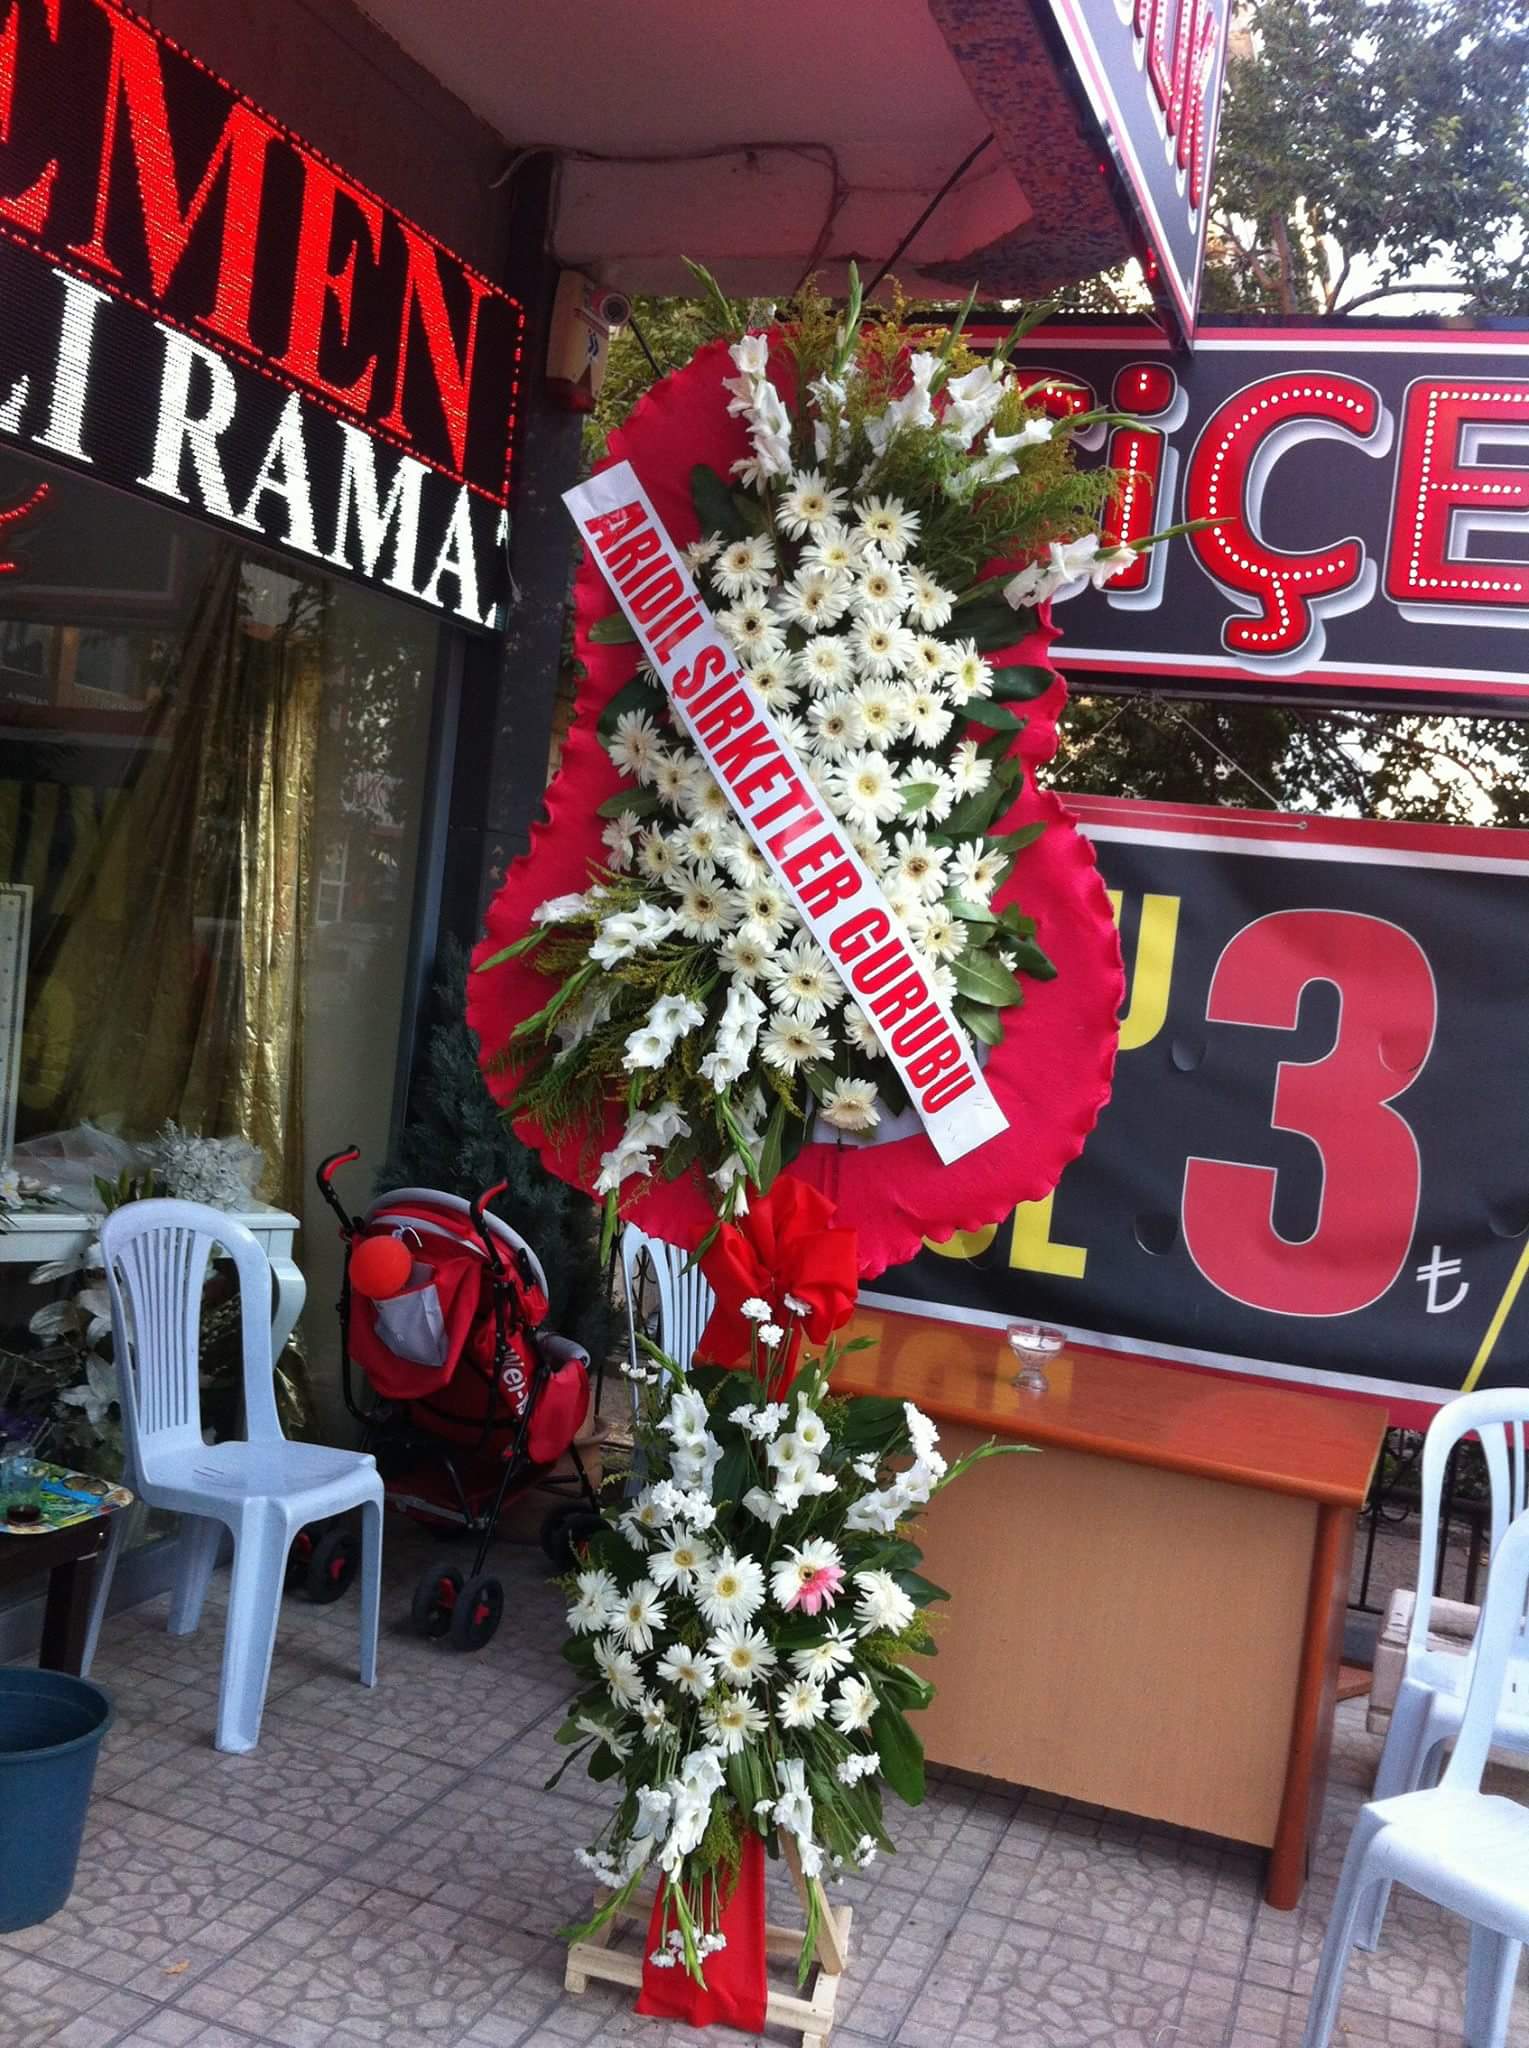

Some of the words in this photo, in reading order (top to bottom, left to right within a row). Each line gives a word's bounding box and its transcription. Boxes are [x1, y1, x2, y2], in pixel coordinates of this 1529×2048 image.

[137, 320, 510, 630] RAMA
[828, 910, 976, 1113] GURUBU
[1181, 908, 1438, 1318] 3
